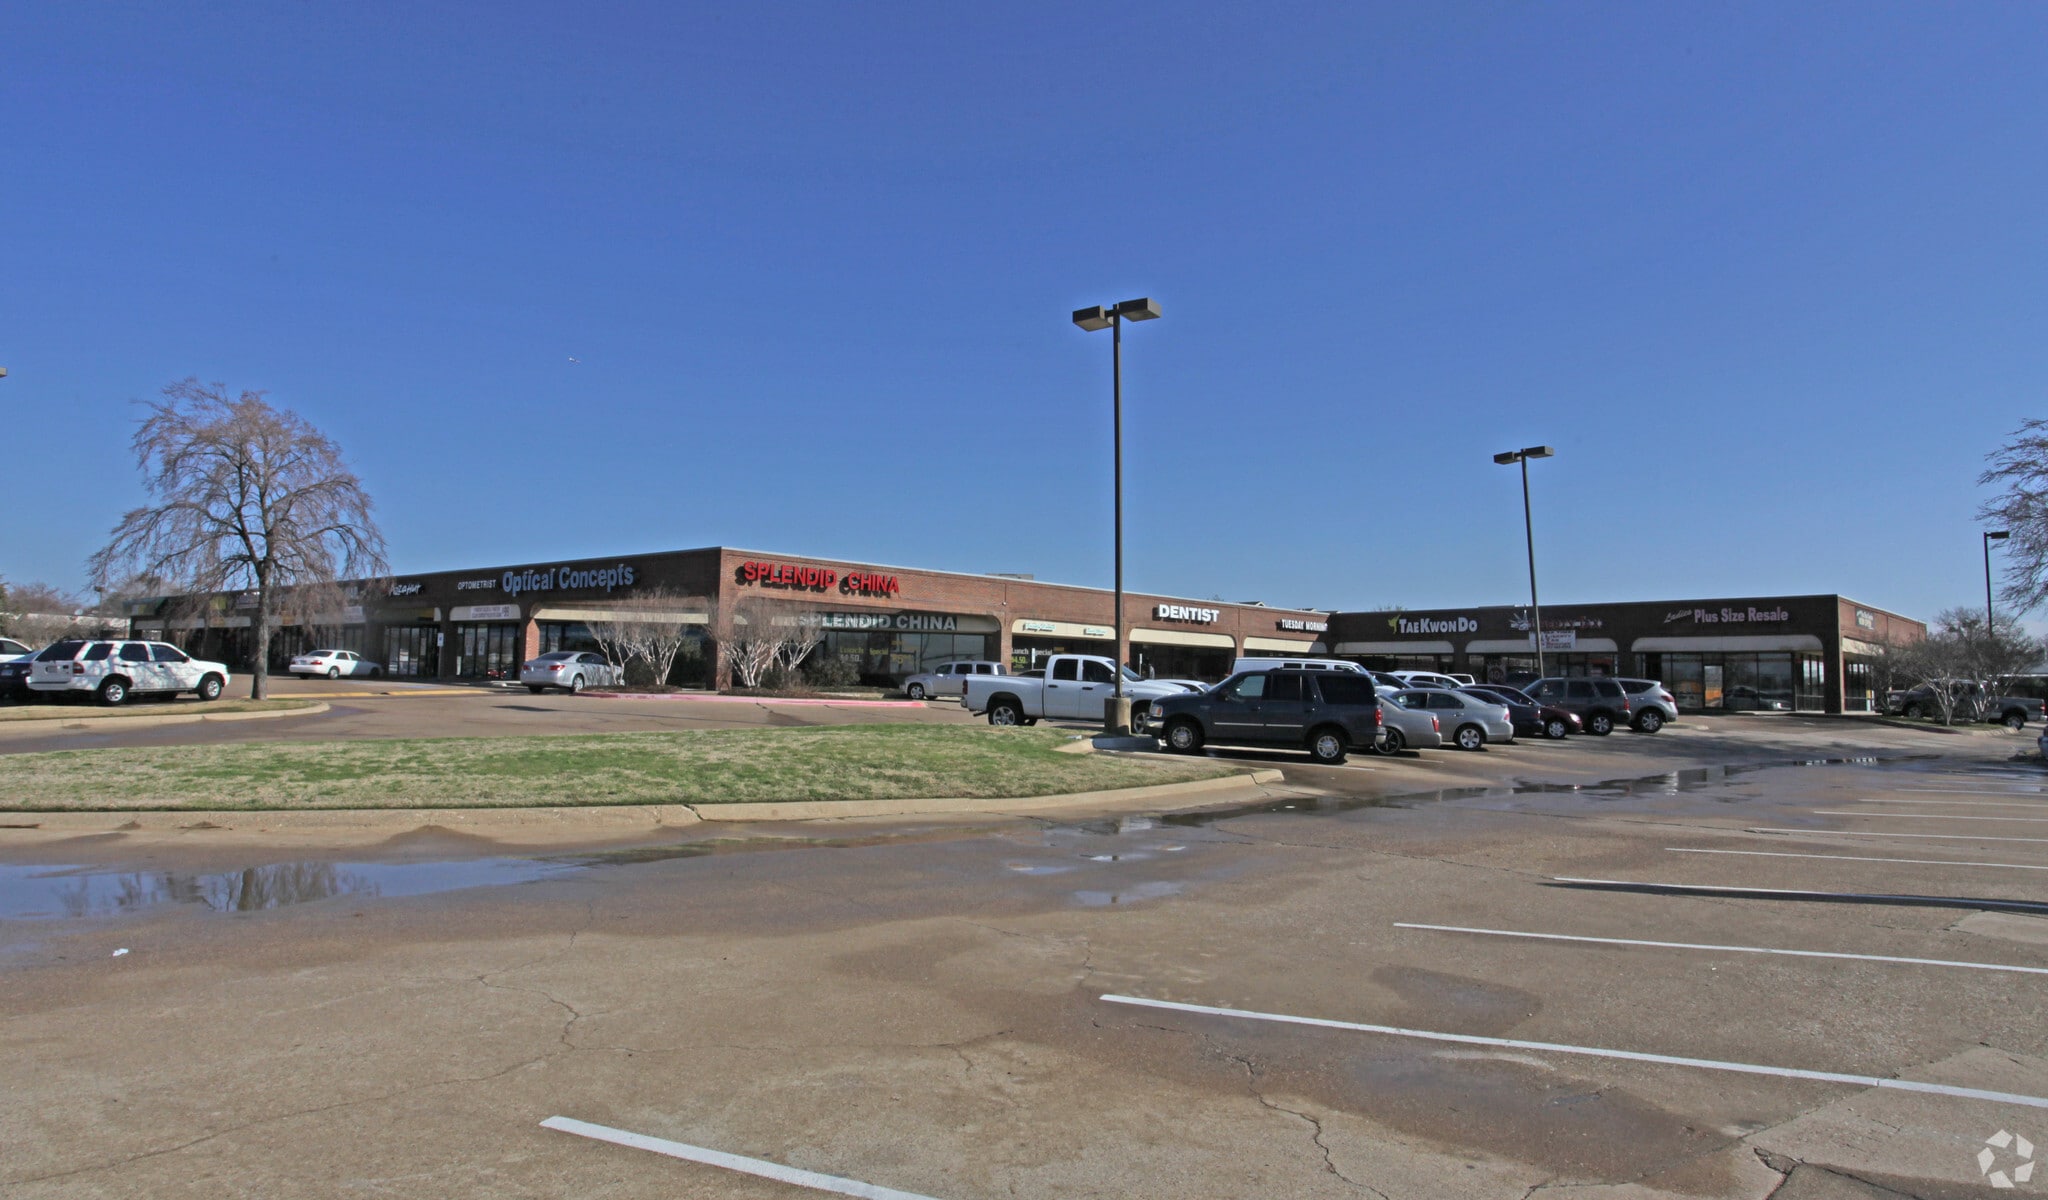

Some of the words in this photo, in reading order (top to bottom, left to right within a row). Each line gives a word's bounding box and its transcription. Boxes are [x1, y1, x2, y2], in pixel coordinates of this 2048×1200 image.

[457, 579, 497, 590] OPTOMETRIST
[503, 570, 555, 597] Optical
[559, 564, 634, 593] Concepts
[744, 562, 837, 587] SPLENDID
[848, 572, 899, 593] CHINA
[799, 612, 891, 629] SPLENDID
[896, 615, 956, 630] CHINA
[1158, 603, 1220, 623] DENTIST
[1694, 609, 1718, 623] Plus
[1721, 608, 1745, 622] Size
[1748, 607, 1789, 622] Resale
[1281, 619, 1304, 631] TUESDAY
[1305, 621, 1328, 633] MORNING
[839, 646, 864, 654] Lunch
[869, 647, 889, 656] Special
